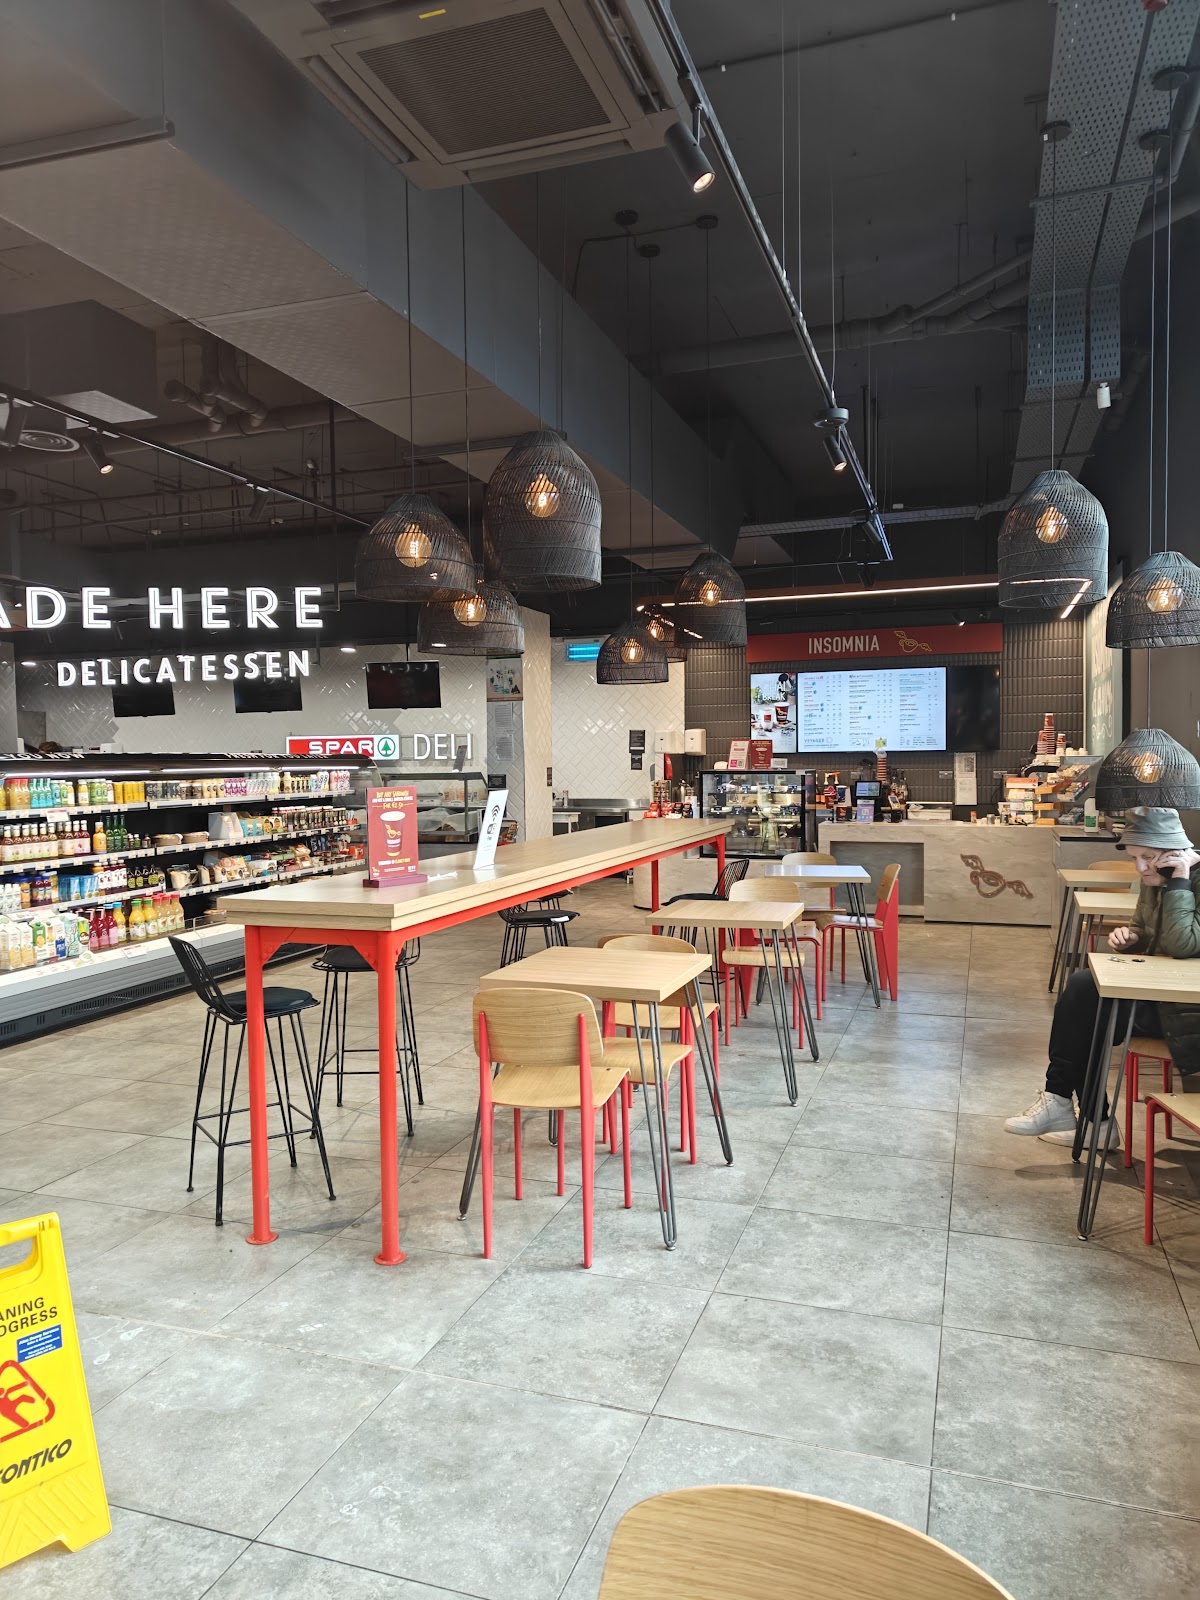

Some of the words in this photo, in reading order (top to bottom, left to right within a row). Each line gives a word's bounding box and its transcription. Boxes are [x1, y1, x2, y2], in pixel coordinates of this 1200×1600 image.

[0, 586, 112, 629] DE
[148, 586, 324, 629] HERE
[808, 635, 880, 654] INSOMNIA
[57, 650, 310, 687] DELICATESSEN
[308, 739, 374, 755] SPAR
[413, 733, 472, 760] DELI
[0, 1438, 73, 1485] ONTICO
